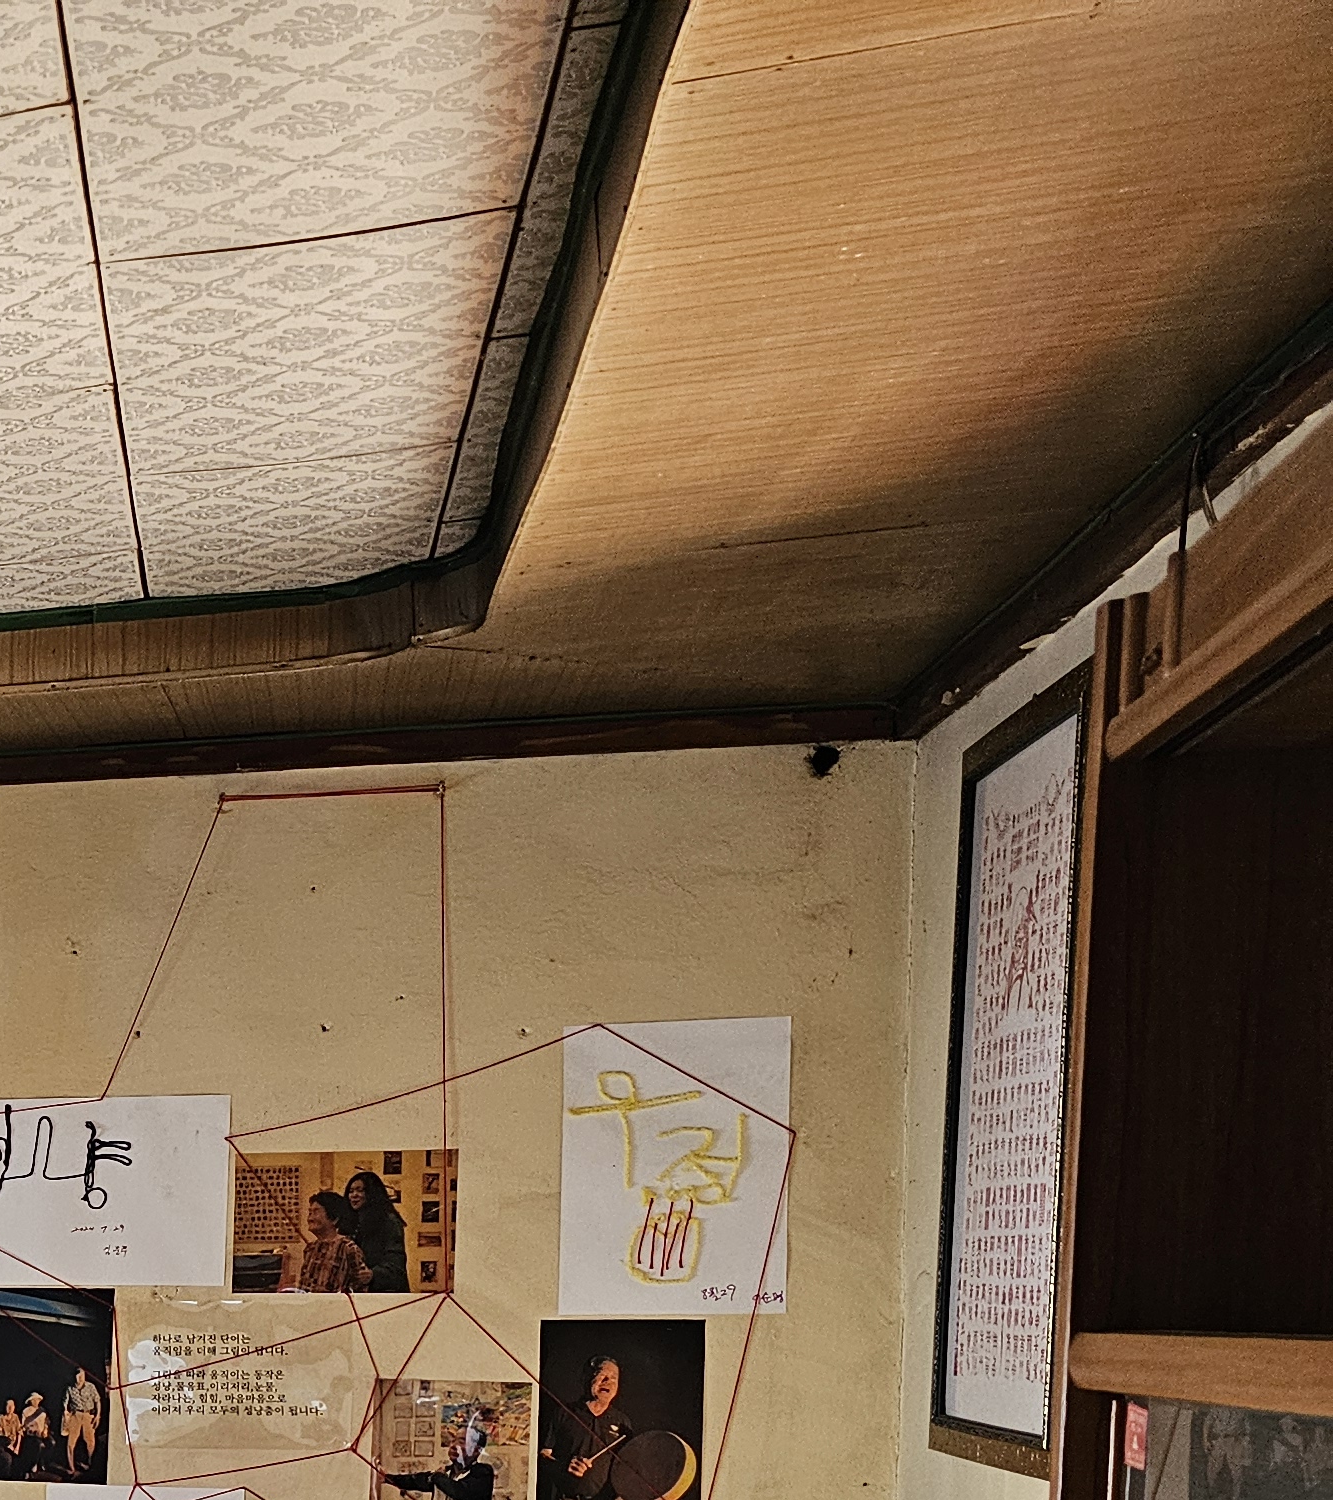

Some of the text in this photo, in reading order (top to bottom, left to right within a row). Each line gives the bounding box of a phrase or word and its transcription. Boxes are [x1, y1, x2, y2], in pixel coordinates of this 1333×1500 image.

[152, 1334, 183, 1344] 하나로
[220, 1334, 251, 1344] 단어는
[153, 1346, 193, 1356] 움직임을
[197, 1346, 217, 1356] 더해
[186, 1370, 205, 1380] 따라
[209, 1370, 250, 1380] 움직이는
[254, 1370, 285, 1380] 동작은
[151, 1394, 287, 1404] 자라나는, 마음마음으로
[185, 1406, 205, 1415] 우리
[208, 1406, 240, 1416] 모두의
[288, 1406, 324, 1416] 됩니다.
